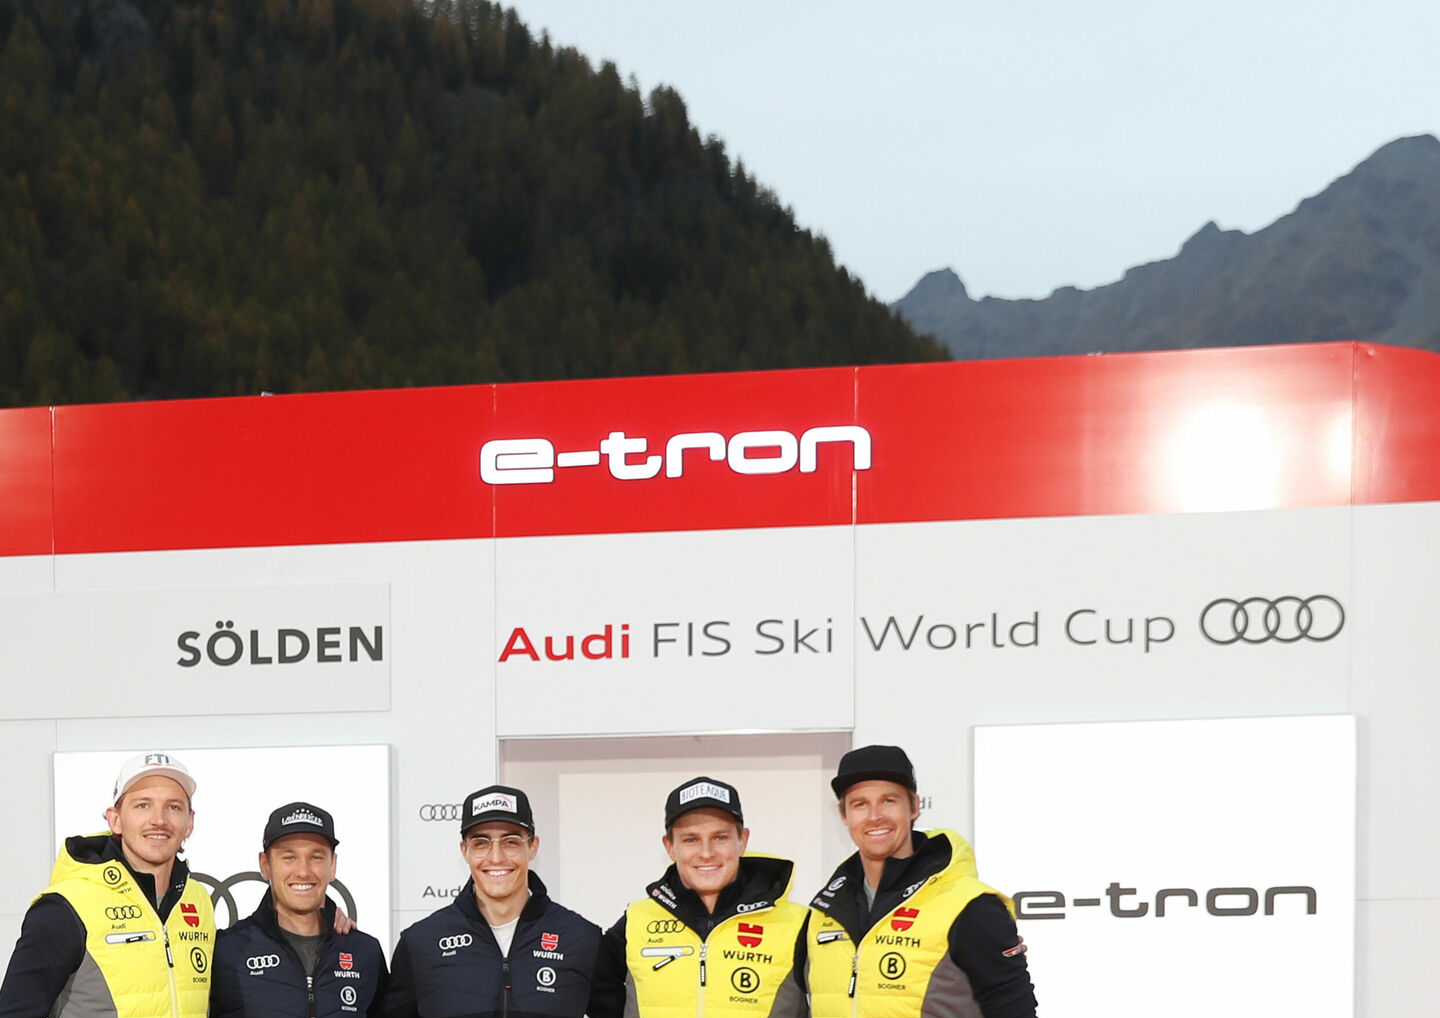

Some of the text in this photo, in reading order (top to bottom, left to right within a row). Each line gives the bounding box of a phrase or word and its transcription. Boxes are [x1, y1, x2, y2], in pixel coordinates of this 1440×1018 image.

[480, 426, 871, 485] e-tron
[177, 621, 383, 667] SÖLDEN
[499, 609, 1175, 662] Audi FIS Ski World Cup
[473, 799, 509, 812] KAMPA
[422, 885, 462, 898] Aud
[1014, 882, 1317, 920] e-tron
[723, 950, 773, 964] WÜRTH
[729, 996, 758, 1004] BOGNER
